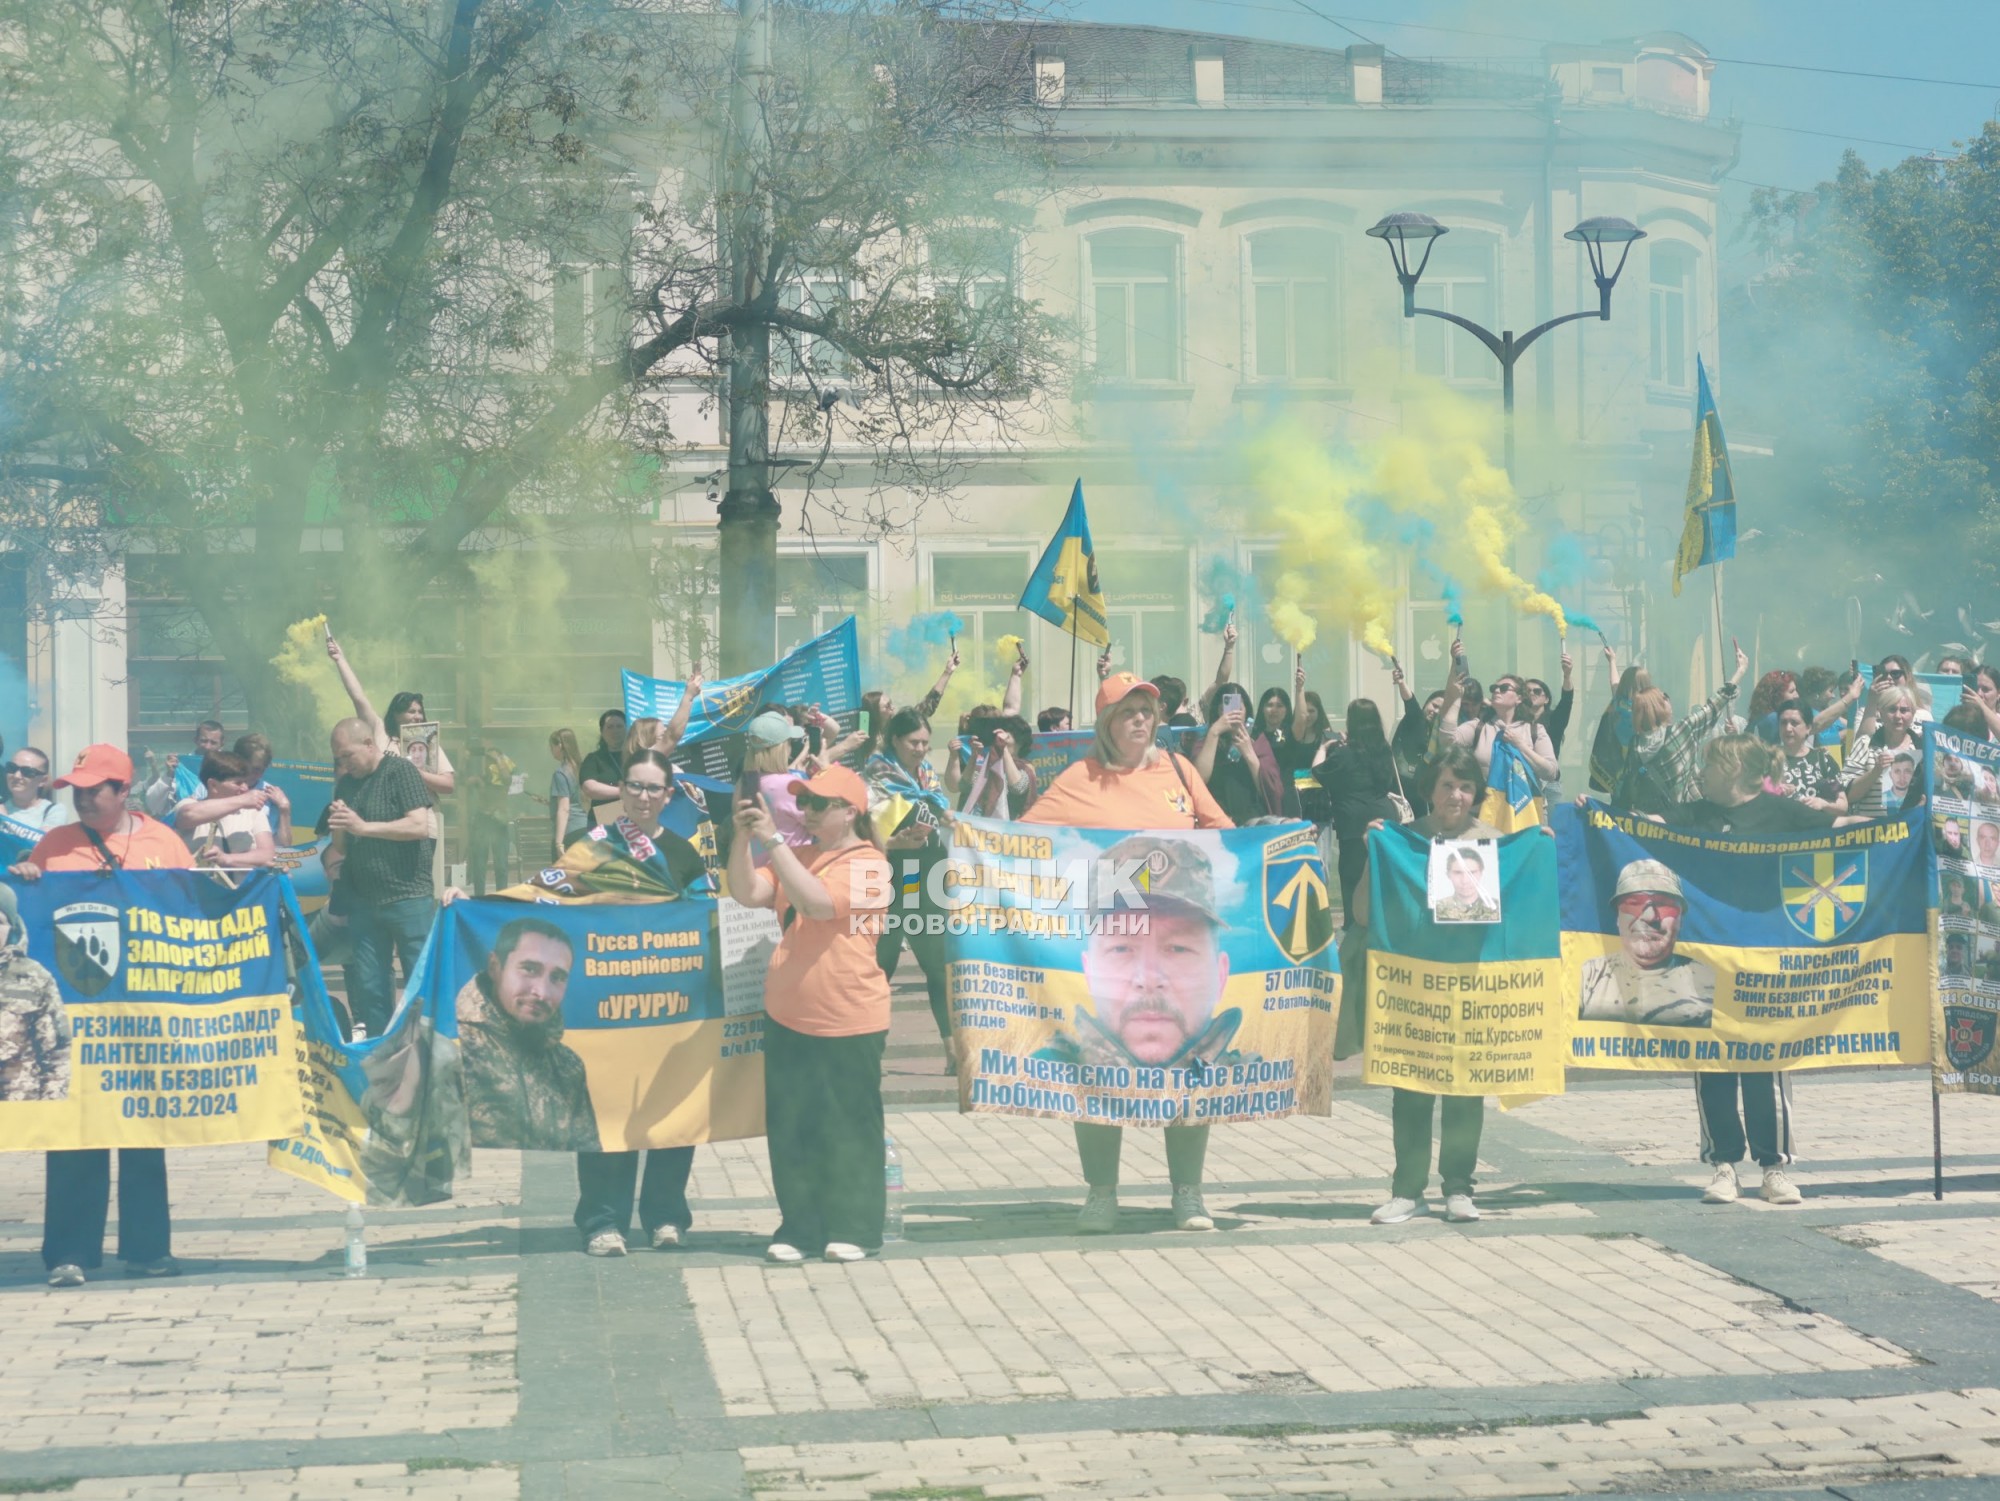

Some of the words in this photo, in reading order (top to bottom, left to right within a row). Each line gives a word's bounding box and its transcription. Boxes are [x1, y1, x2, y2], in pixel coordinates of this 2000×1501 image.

[954, 821, 1053, 860] Музика
[1637, 821, 1701, 847] ОКРЕМА
[1704, 838, 1831, 853] МЕХАНІЗОВАНА
[1835, 821, 1910, 846] БРИГАДА
[126, 907, 161, 933] 118
[165, 905, 266, 942] БРИГАДА
[127, 932, 271, 967] ЗАПОРІЗЬКИЙ
[587, 932, 638, 953] Гусєв
[642, 930, 700, 949] Роман
[585, 954, 704, 977] Валерійович
[984, 962, 1044, 984] безвісти
[1735, 970, 1786, 988] СЕРГІЙ
[1790, 957, 1894, 988] МИКОЛАЙОВИЧ
[1779, 949, 1860, 971] ЖАРСЬКИЙ
[126, 967, 241, 995] НАПРЯМОК
[1265, 970, 1281, 992] 57
[1376, 964, 1412, 985] СИН
[1423, 968, 1544, 993] ВЕРБИЦЬКИЙ
[1733, 989, 1765, 1004] ЗНИК
[1768, 988, 1825, 1004] БЕЗВІСТИ
[1882, 978, 1893, 992] р.
[1263, 998, 1276, 1012] 42
[1376, 989, 1451, 1023] Олександр
[1462, 1000, 1544, 1024] Вікторович
[72, 1015, 162, 1038] РЕЗИНКА
[168, 1008, 281, 1038] ОЛЕКСАНДР
[723, 1022, 746, 1038] 225
[960, 1012, 1006, 1029] Ягідне
[1374, 1022, 1402, 1037] зник
[1405, 1023, 1456, 1044] безвісти
[1465, 1028, 1483, 1044] під
[1486, 1027, 1543, 1047] Курськом
[1572, 1036, 1595, 1057] МИ
[1599, 1036, 1690, 1060] ЧЕКАЄМО
[1695, 1039, 1721, 1060] НА
[1726, 1040, 1774, 1061] ТВОЄ
[1778, 1031, 1900, 1059] ПОВЕРНЕННЯ
[80, 1035, 278, 1065] ПАНТЕЛЕЙМОНОВИЧ
[1383, 1046, 1415, 1058] вересня
[1417, 1049, 1434, 1060] 2024
[1435, 1053, 1454, 1063] року
[1469, 1051, 1482, 1062] 22
[1486, 1050, 1532, 1063] бригада
[100, 1070, 155, 1091] ЗНИК
[161, 1065, 257, 1091] БЕЗВІСТИ
[980, 1047, 1017, 1076] Ми
[1023, 1055, 1131, 1088] чекаємо
[1136, 1067, 1165, 1090] на
[1171, 1059, 1228, 1090] тебе
[1371, 1059, 1454, 1083] ПОВЕРНИСЬ
[1469, 1068, 1534, 1083] ЖИВИМ!
[122, 1093, 238, 1119] 09.03.2024
[971, 1077, 1084, 1117] Любимо,
[1087, 1093, 1178, 1122] віримо
[1182, 1094, 1190, 1119] і
